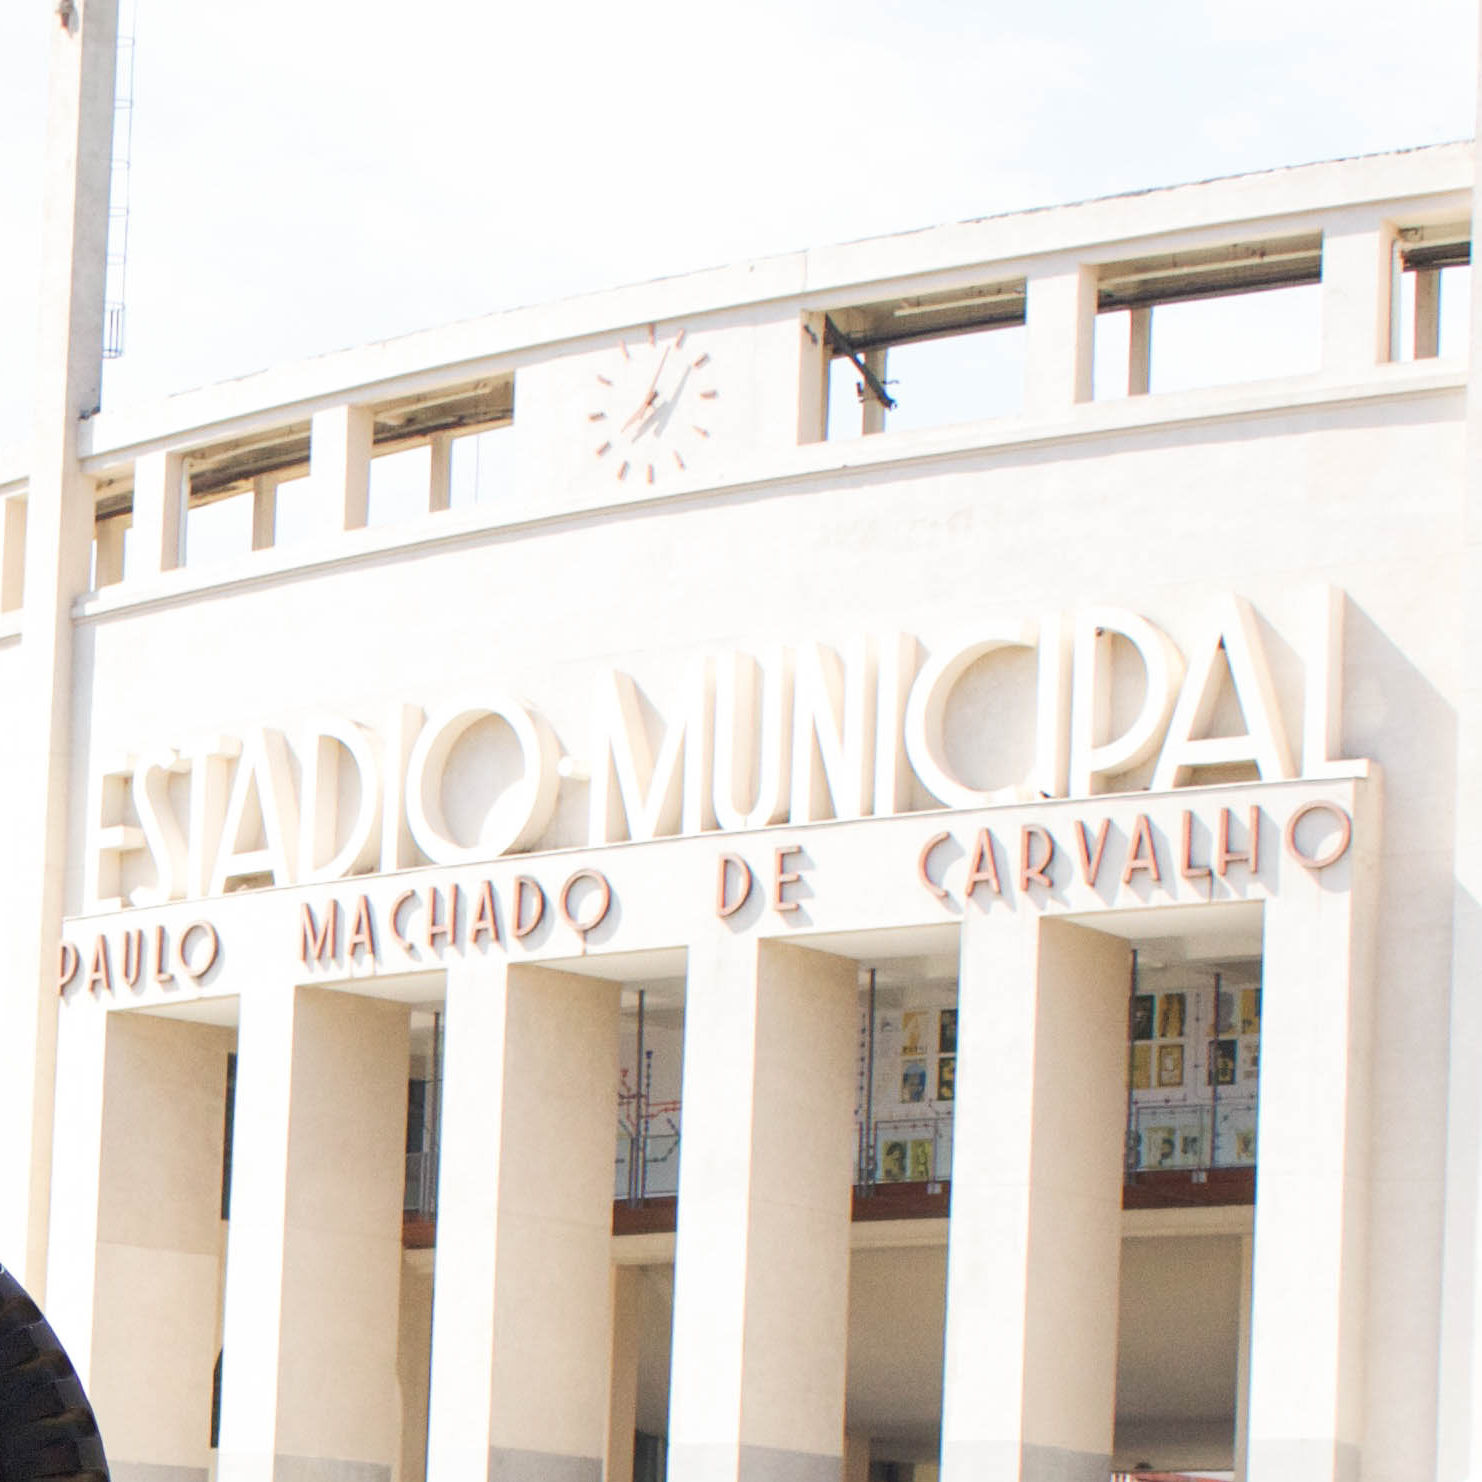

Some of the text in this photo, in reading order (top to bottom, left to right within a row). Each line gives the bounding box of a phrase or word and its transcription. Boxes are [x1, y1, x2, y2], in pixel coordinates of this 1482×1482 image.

[83, 578, 1369, 917] ESTADIO MUNICIPAL
[58, 799, 1351, 996] PAULO MACHADO DE CARVALHO
